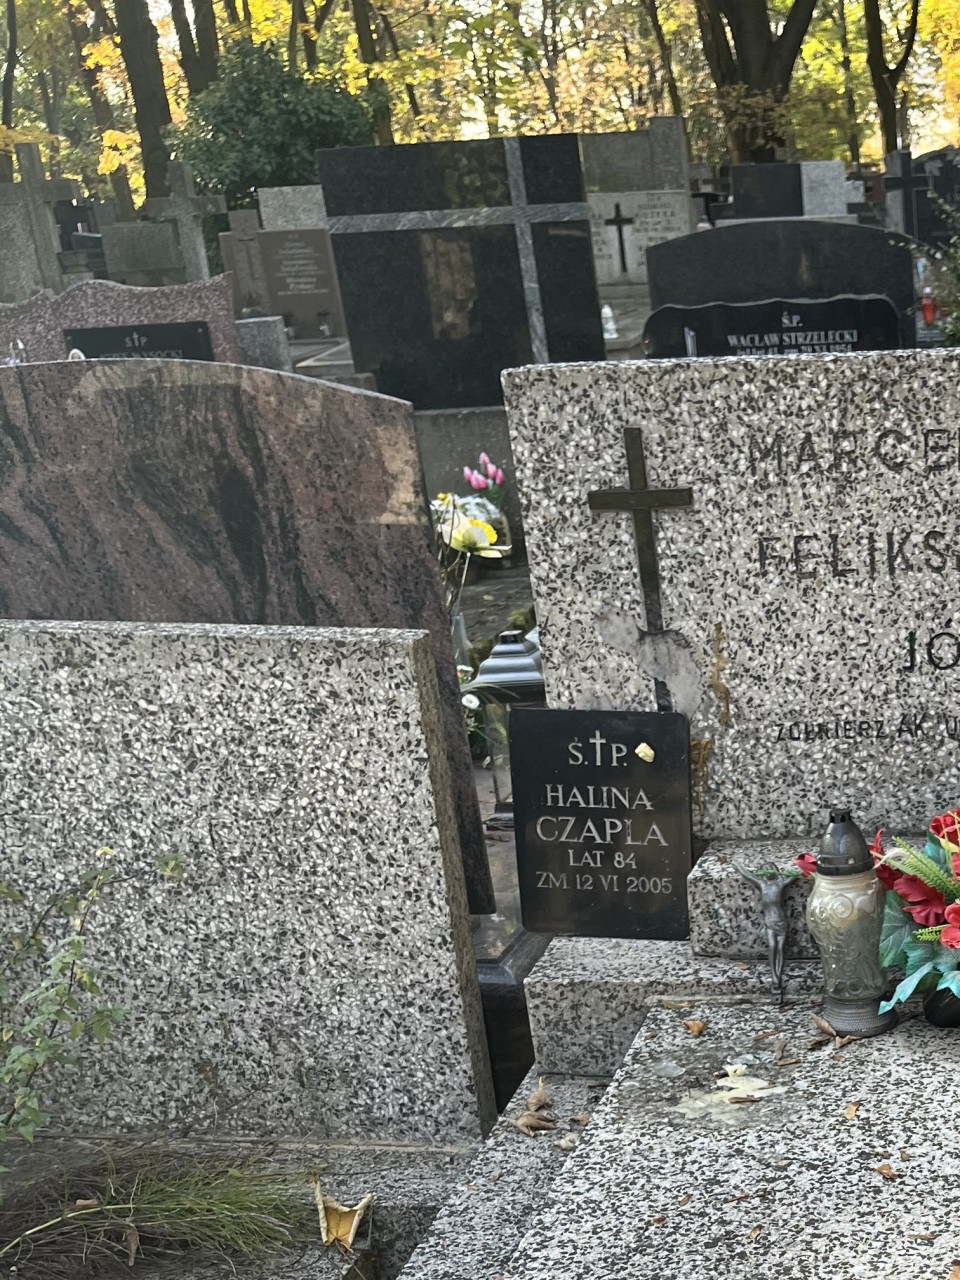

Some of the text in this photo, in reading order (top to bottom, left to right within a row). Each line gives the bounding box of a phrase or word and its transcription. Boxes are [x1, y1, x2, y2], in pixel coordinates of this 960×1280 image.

[782, 330, 858, 345] STRZELECKI
[545, 784, 654, 811] HALINA
[536, 816, 669, 847] CZAPLA
[568, 849, 637, 869] LAT 84
[536, 871, 672, 894] ZM 12 VI 2005
